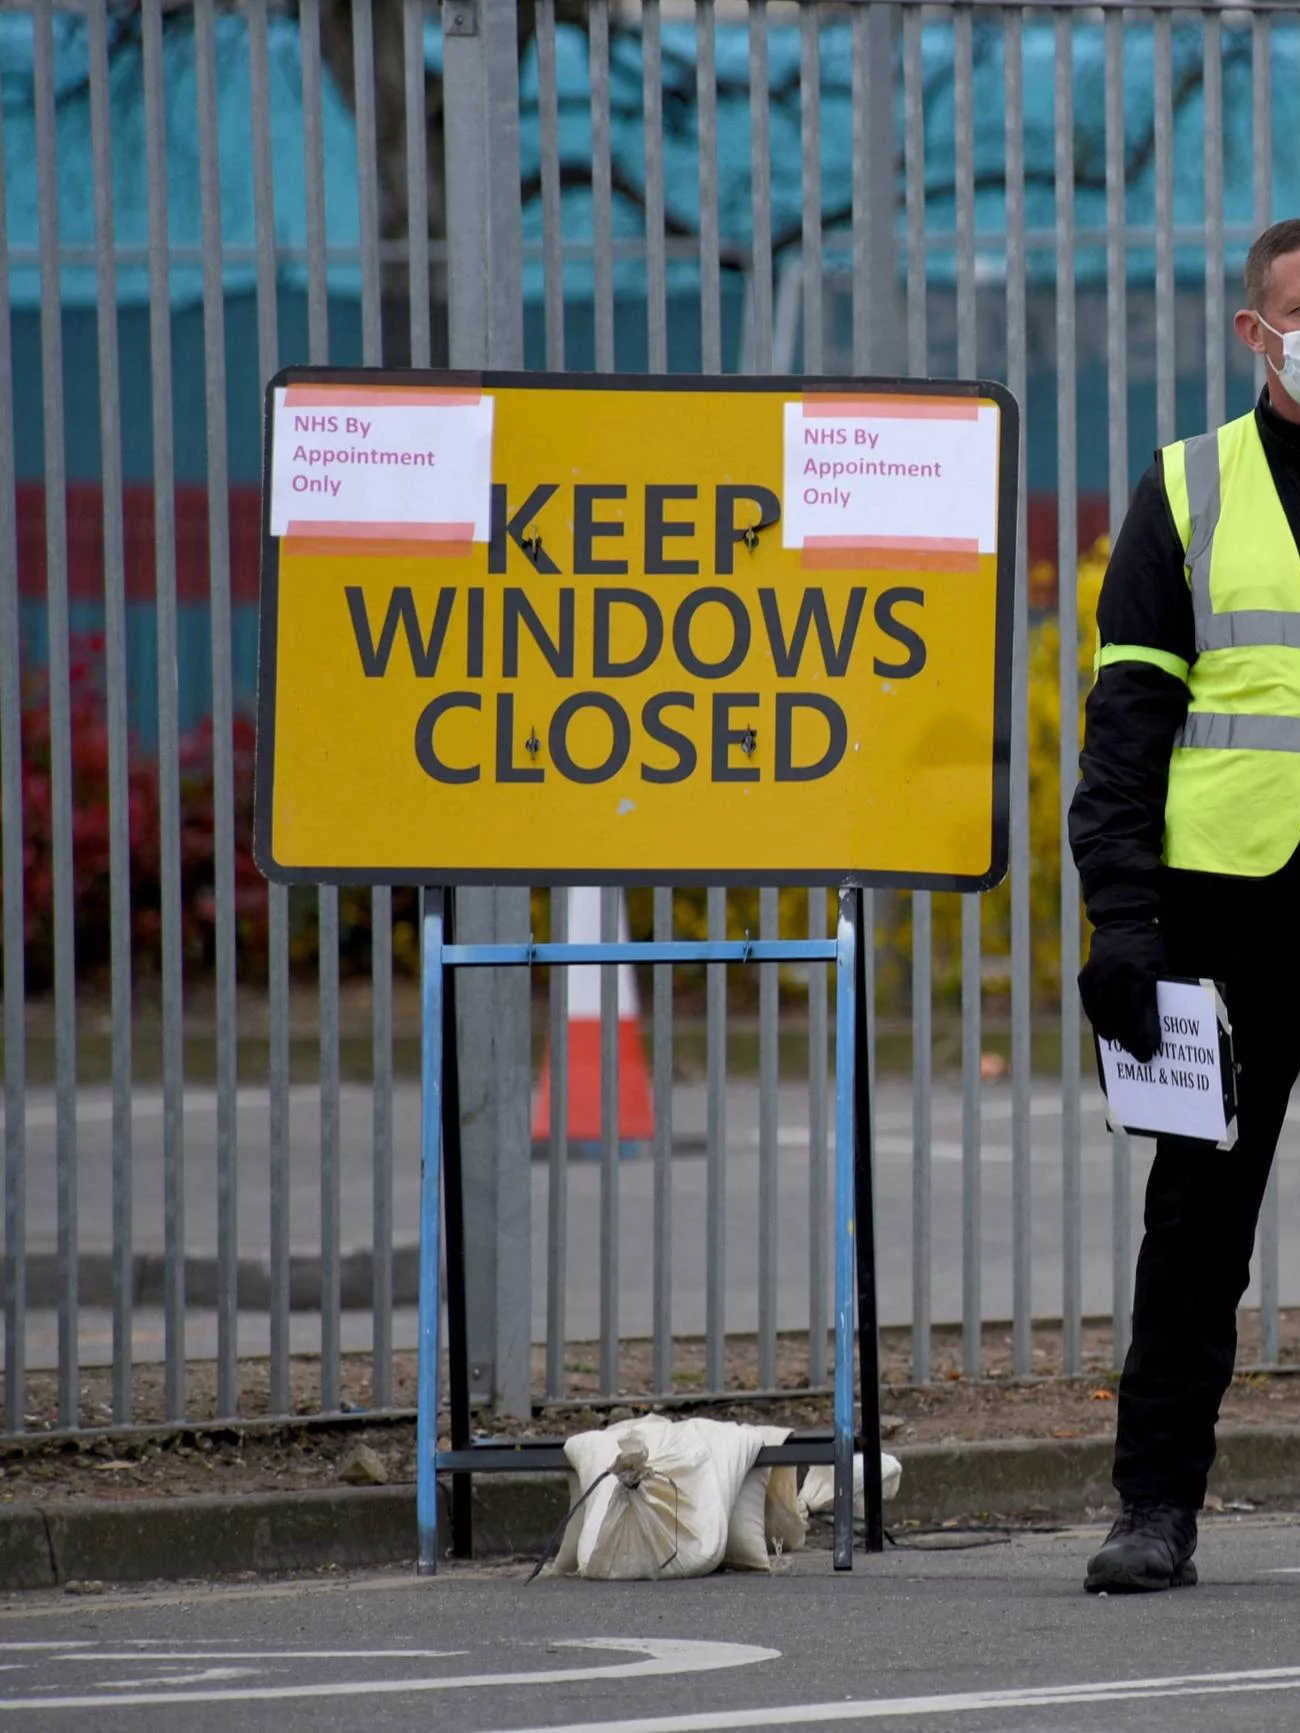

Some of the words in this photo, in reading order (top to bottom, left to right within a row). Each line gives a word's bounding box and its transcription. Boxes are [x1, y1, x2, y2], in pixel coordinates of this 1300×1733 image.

[294, 415, 338, 433] NHS
[345, 416, 372, 439] By
[803, 428, 848, 445] NHS
[853, 428, 880, 450] By
[292, 445, 436, 467] Appointment
[802, 457, 942, 479] Appointment
[291, 474, 343, 497] Only
[802, 487, 851, 509] Only
[487, 483, 781, 576] KEEP
[344, 586, 928, 679] WINDOWS
[413, 690, 848, 785] CLOSED
[1162, 1015, 1201, 1037] SHOW
[1117, 1061, 1156, 1084] EMAIL
[1158, 1067, 1169, 1086] &
[1171, 1069, 1195, 1090] NHS
[1196, 1073, 1211, 1092] ID
